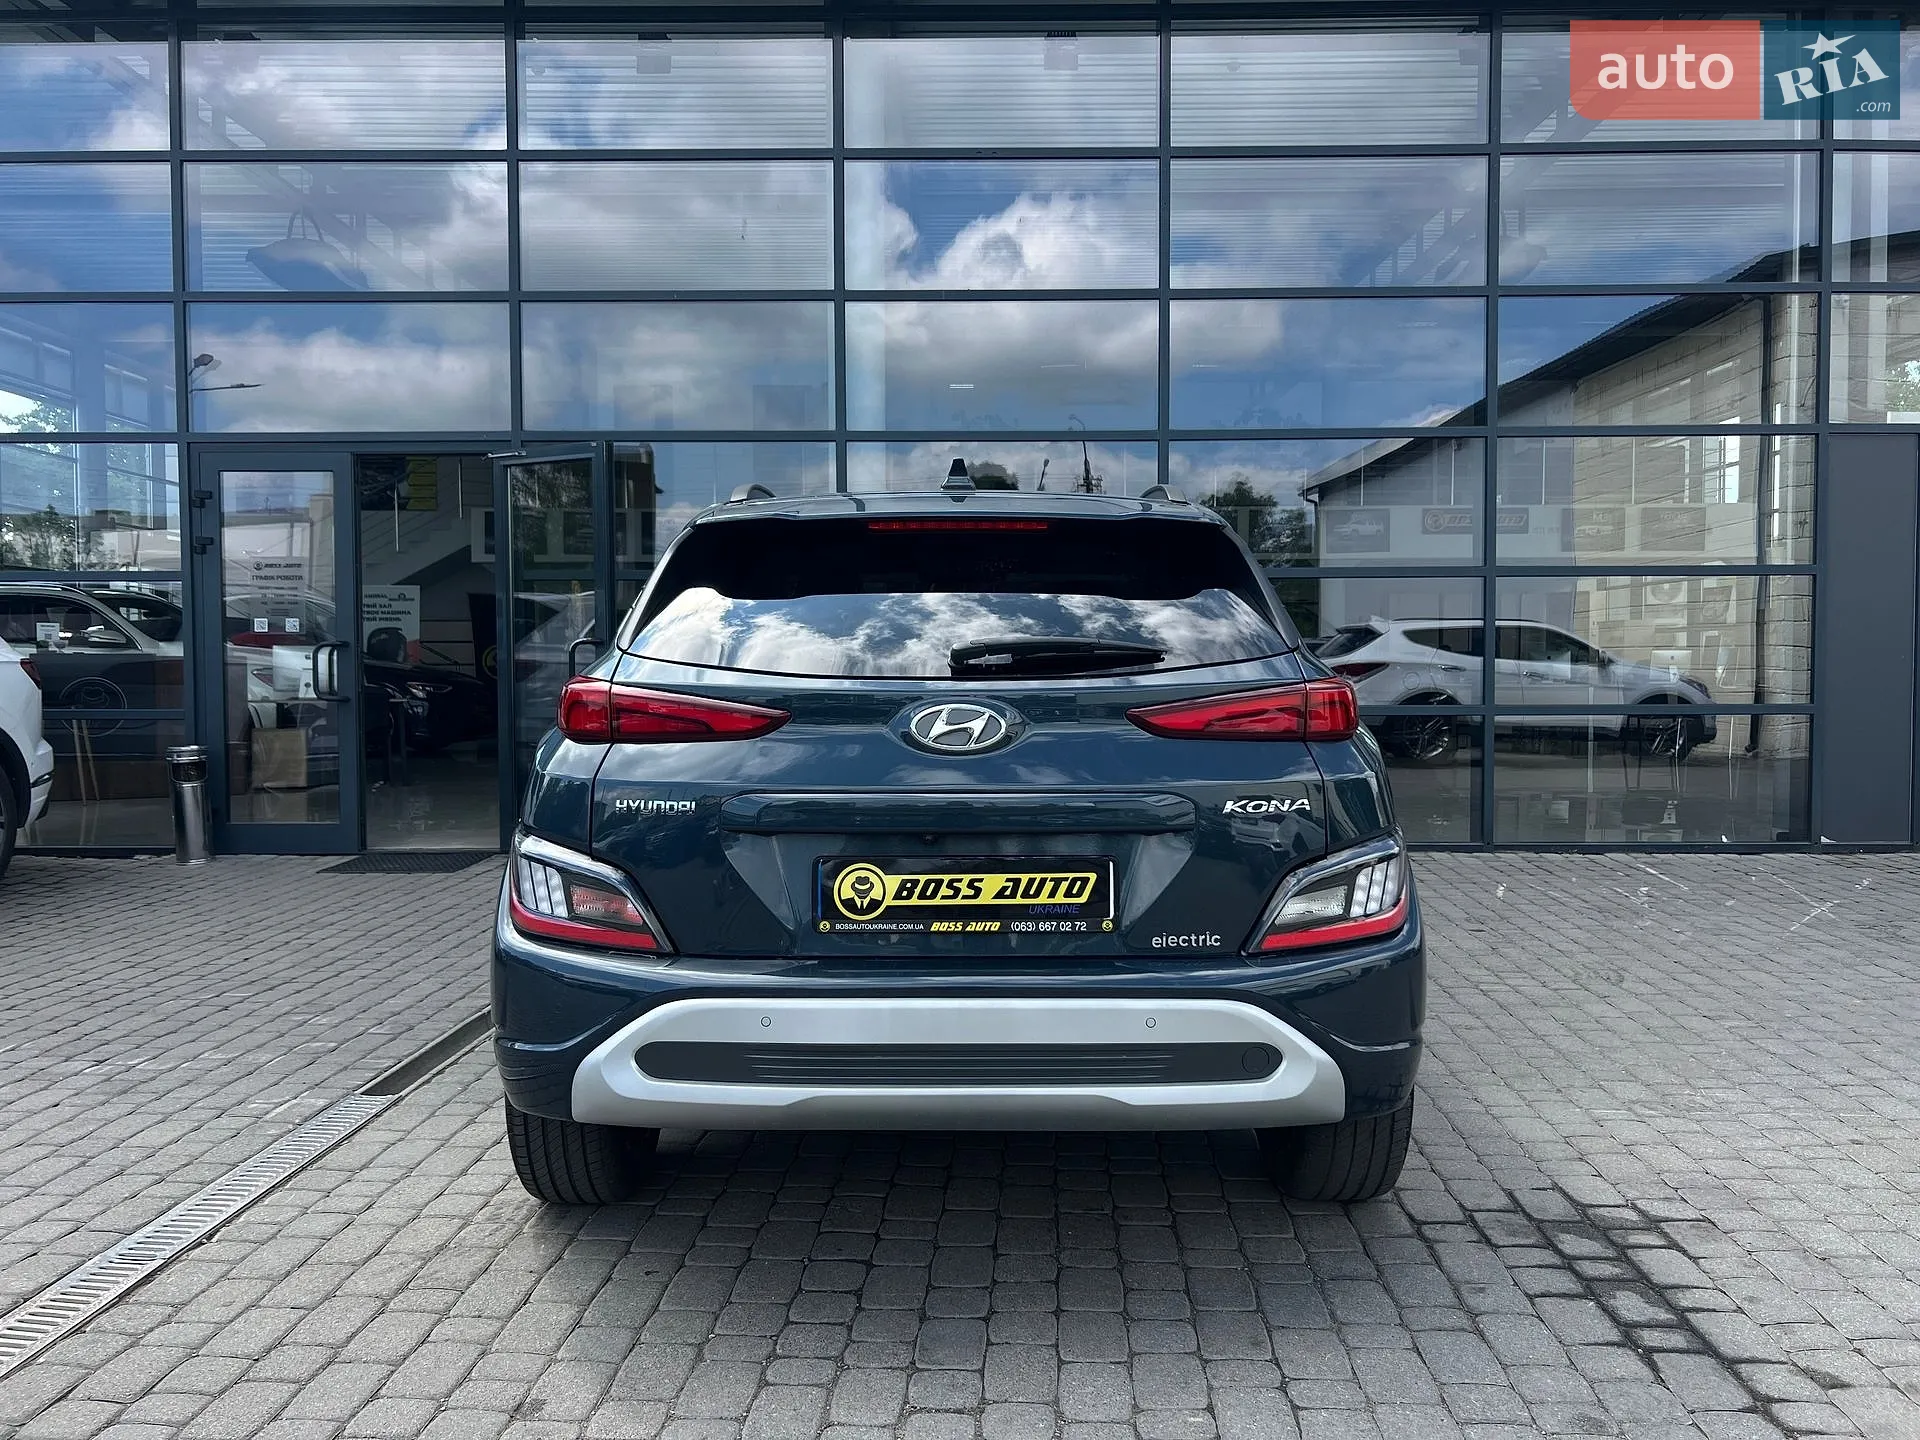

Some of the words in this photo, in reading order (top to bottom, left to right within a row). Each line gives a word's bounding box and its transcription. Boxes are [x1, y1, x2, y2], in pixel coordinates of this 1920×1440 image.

[615, 799, 696, 816] HYUNDAI
[1222, 798, 1311, 814] KONA
[891, 877, 985, 901] BOSS
[991, 876, 1091, 900] AUTO
[1028, 904, 1080, 914] UKRAINE
[835, 922, 924, 931] BOSSAUTOUKRAINE.COM.UA
[930, 921, 964, 932] BOSS
[965, 921, 1001, 932] AUTO
[1010, 921, 1036, 932] (063)
[1038, 921, 1056, 931] 667
[1059, 921, 1072, 931] 02
[1074, 921, 1087, 931] 72
